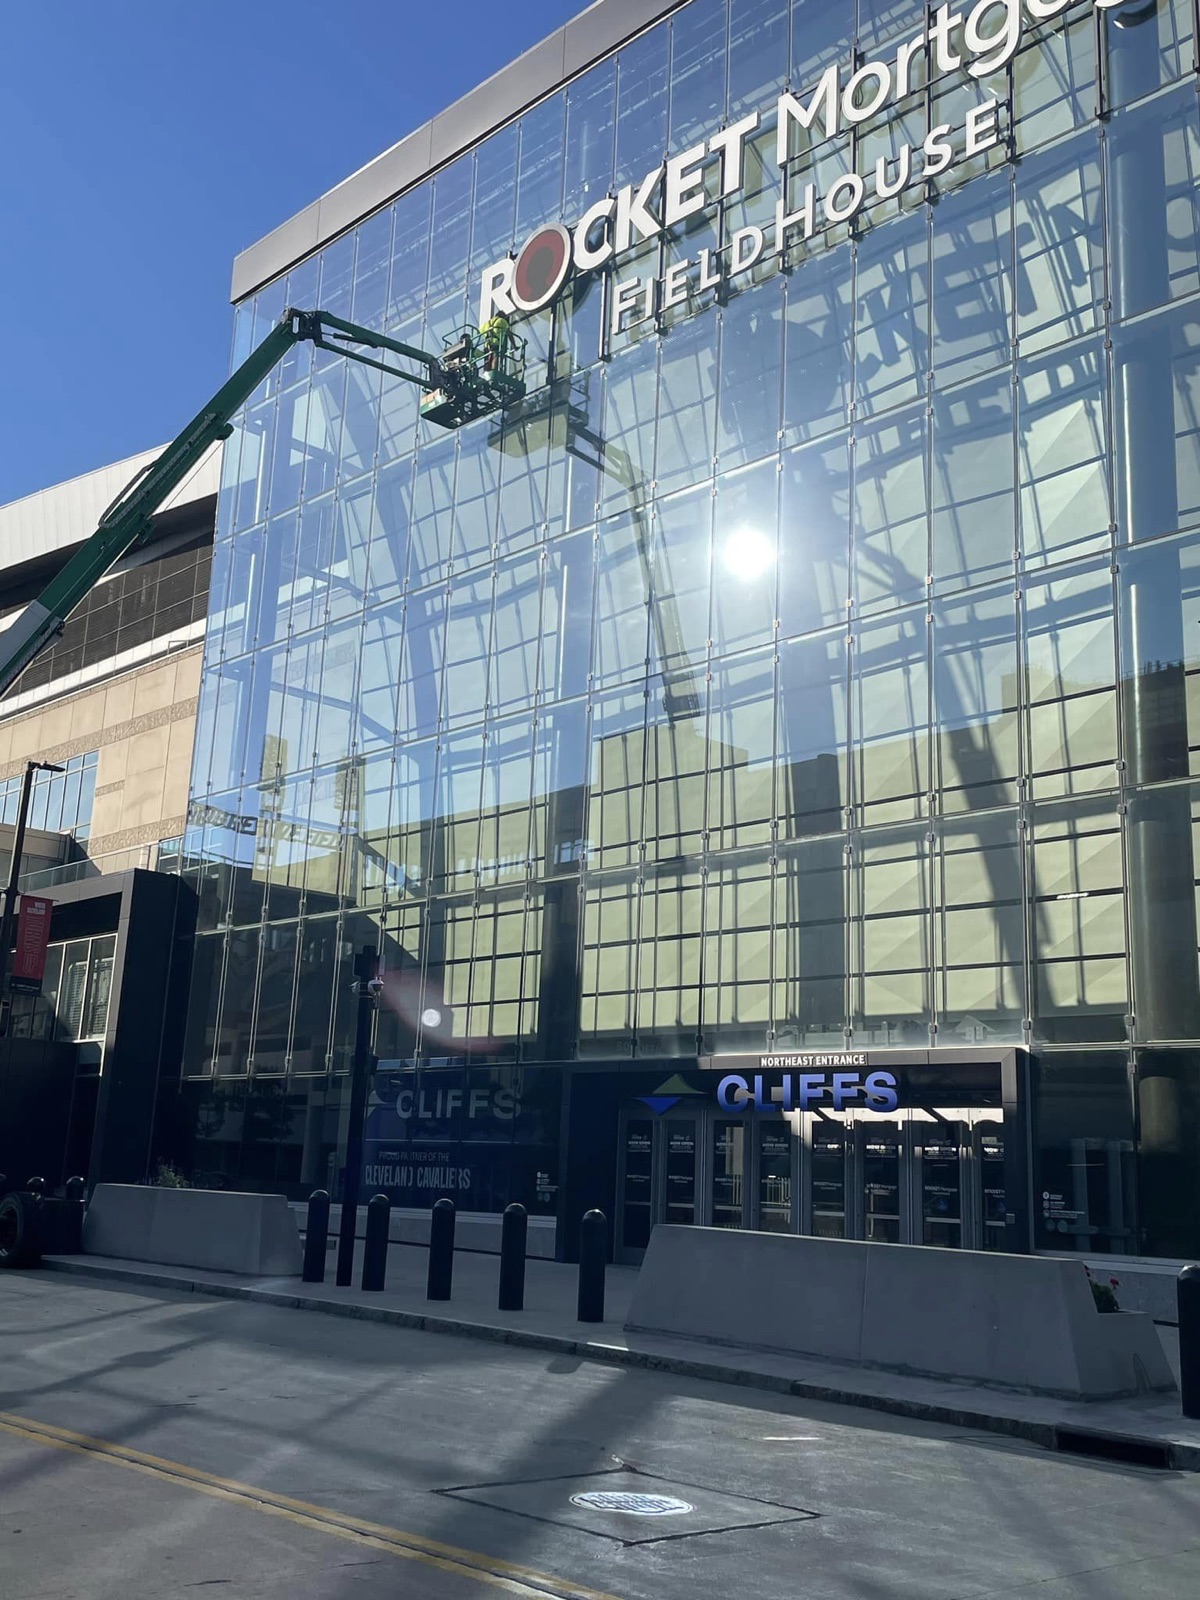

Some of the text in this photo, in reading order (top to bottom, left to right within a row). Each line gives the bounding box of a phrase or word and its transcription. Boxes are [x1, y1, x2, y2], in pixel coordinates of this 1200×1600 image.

[479, 112, 762, 329] ROCKET
[776, 0, 1122, 167] Mortg
[612, 98, 999, 335] FIELDHOUSE
[760, 1054, 865, 1067] NORTHEAST ENTRANCE
[396, 1088, 522, 1119] CLIFFS
[717, 1071, 898, 1112] CLIFFS
[438, 1152, 450, 1162] THE
